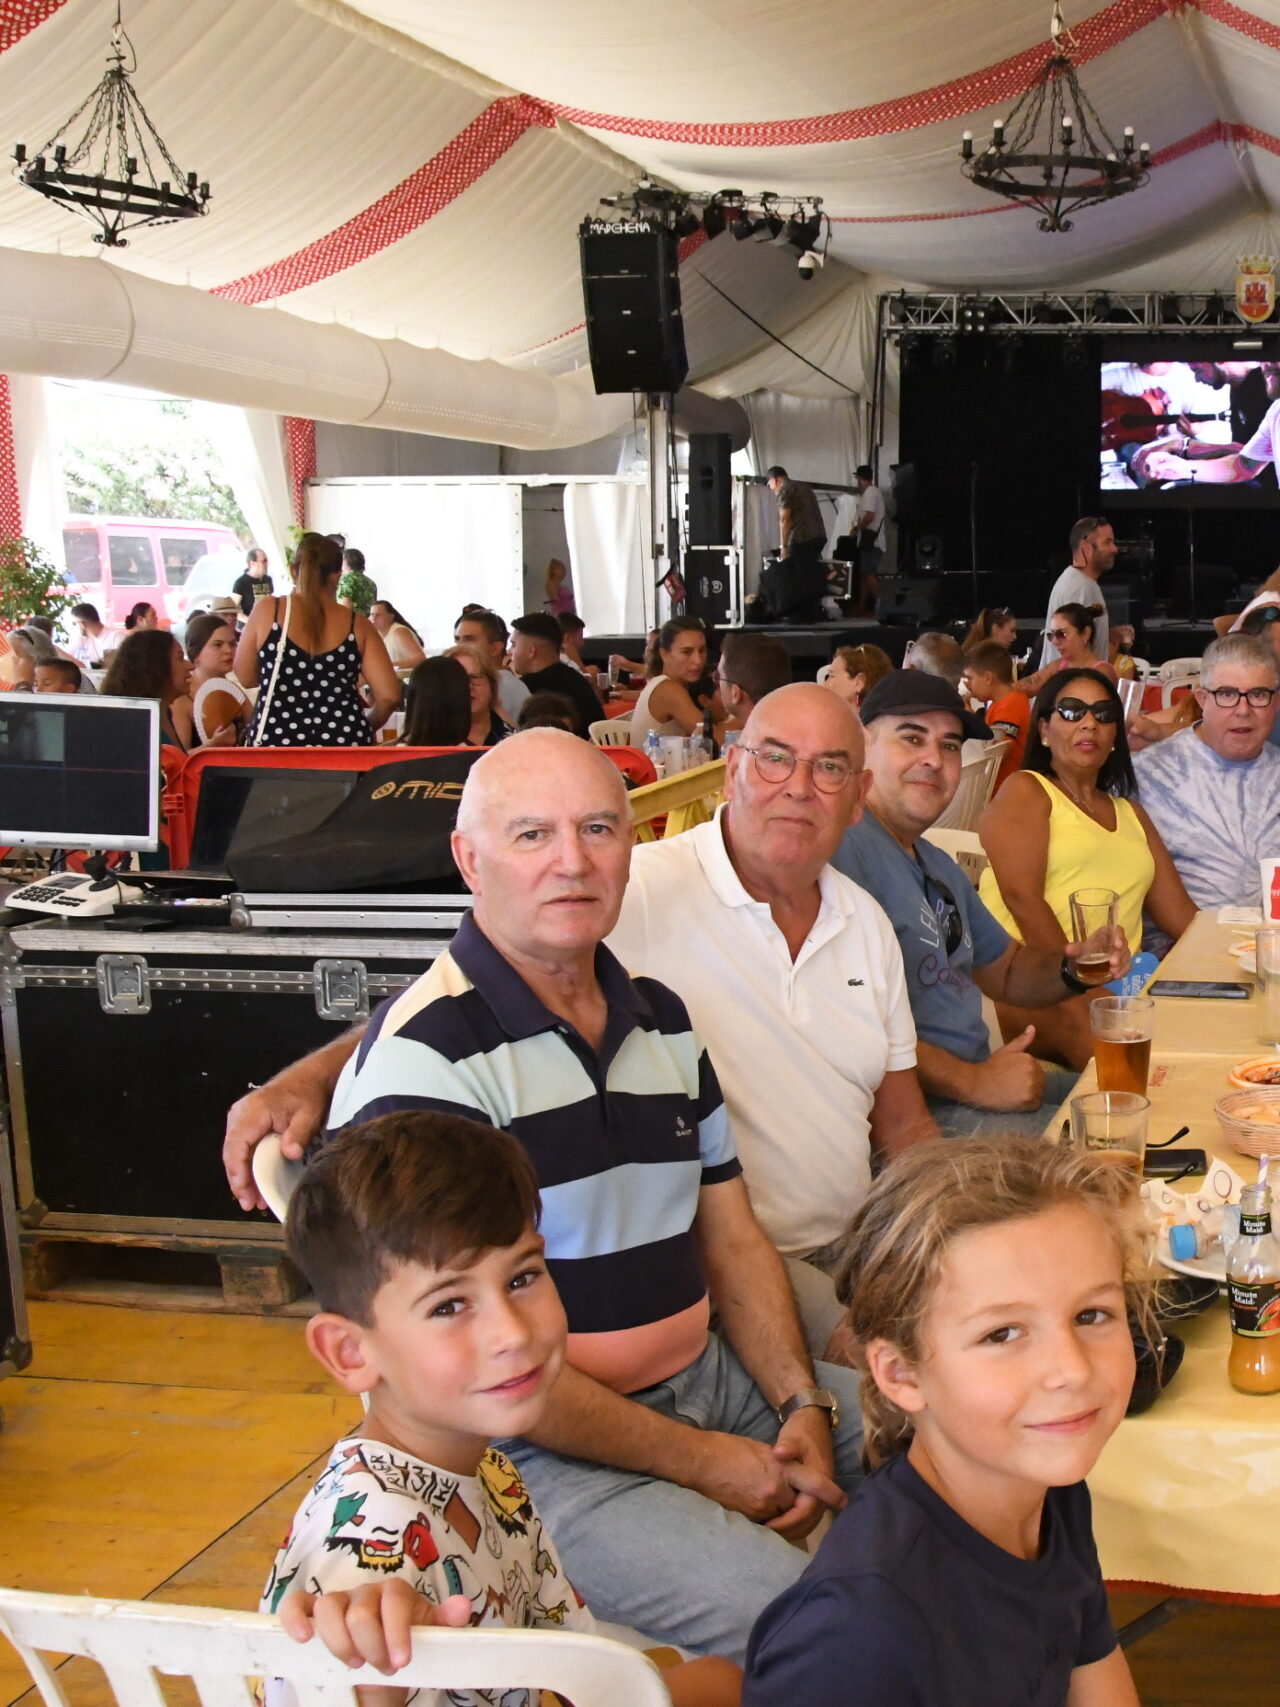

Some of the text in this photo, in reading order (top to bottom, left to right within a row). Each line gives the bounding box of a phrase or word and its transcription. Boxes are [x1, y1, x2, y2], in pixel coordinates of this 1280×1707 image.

[1245, 1226, 1264, 1234] Maid
[1231, 1286, 1258, 1299] Minute
[1234, 1296, 1255, 1306] Maid
